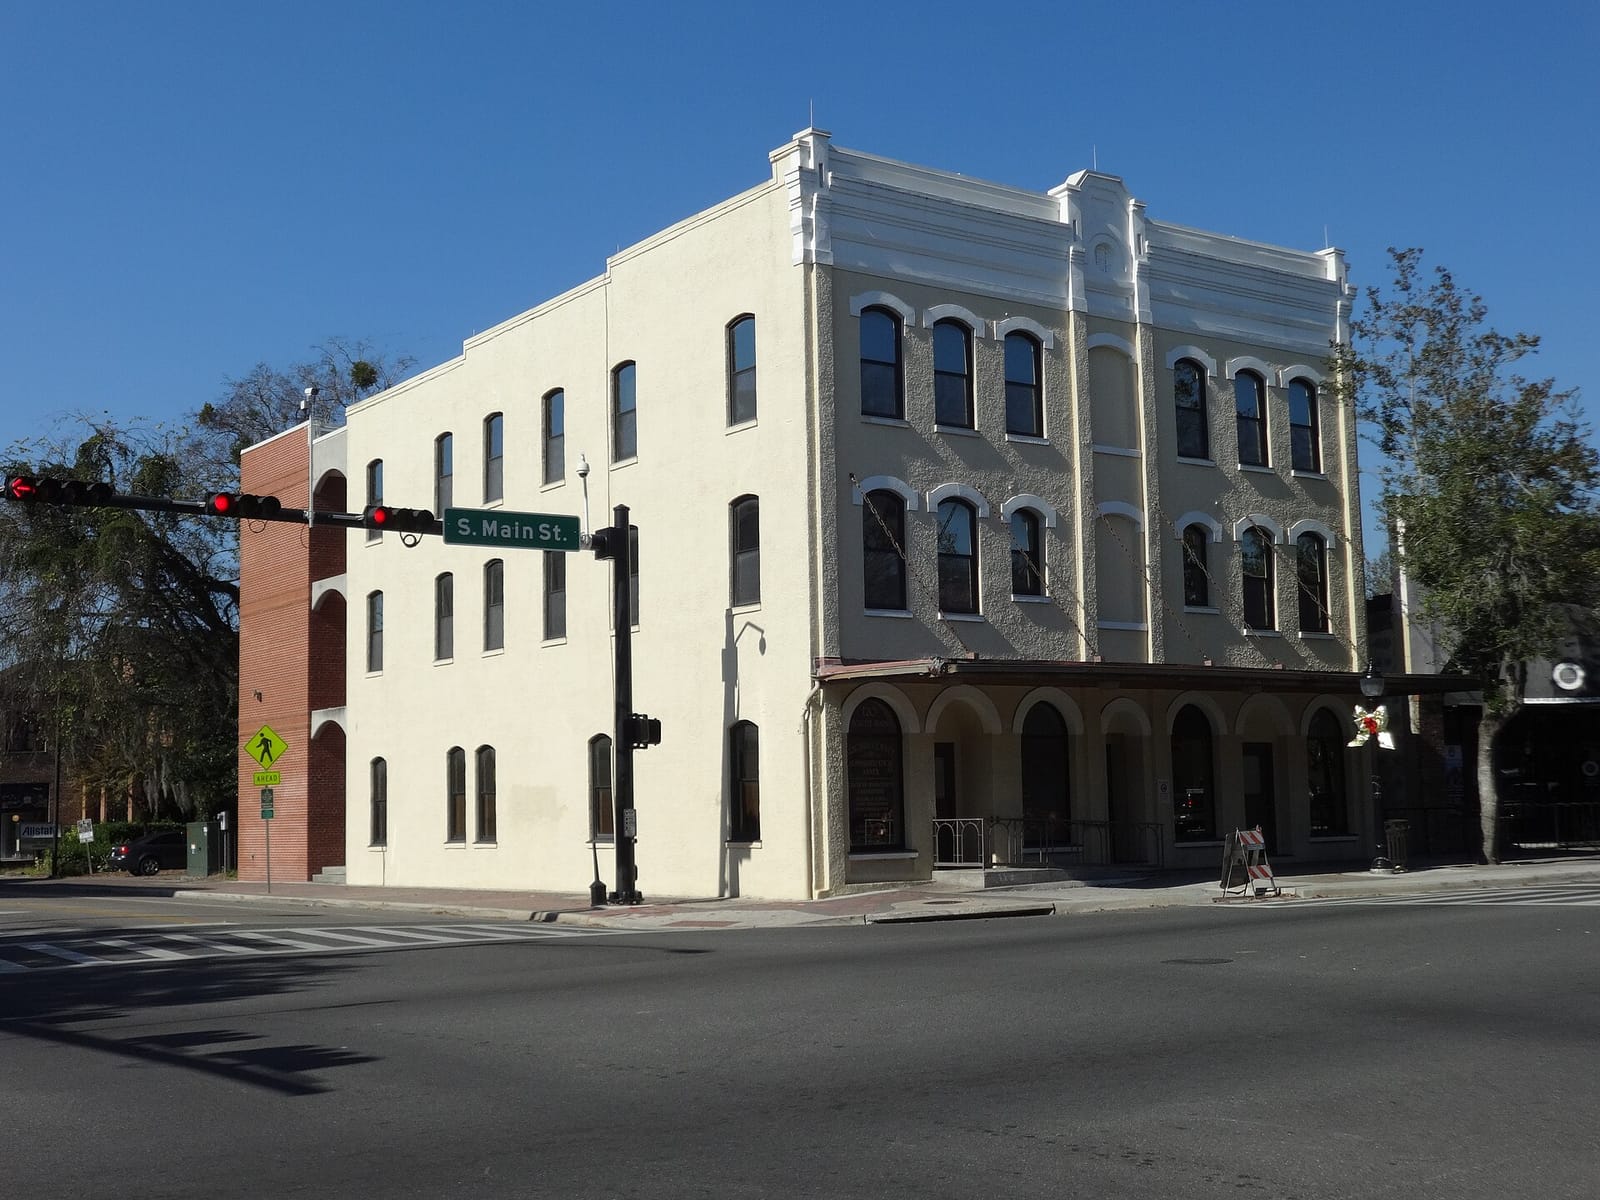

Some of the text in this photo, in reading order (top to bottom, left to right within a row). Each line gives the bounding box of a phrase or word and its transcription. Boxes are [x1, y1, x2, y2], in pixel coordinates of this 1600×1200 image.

[457, 518, 568, 542] S. Main St.
[256, 775, 278, 783] AHEAD
[22, 826, 53, 836] Allstat
